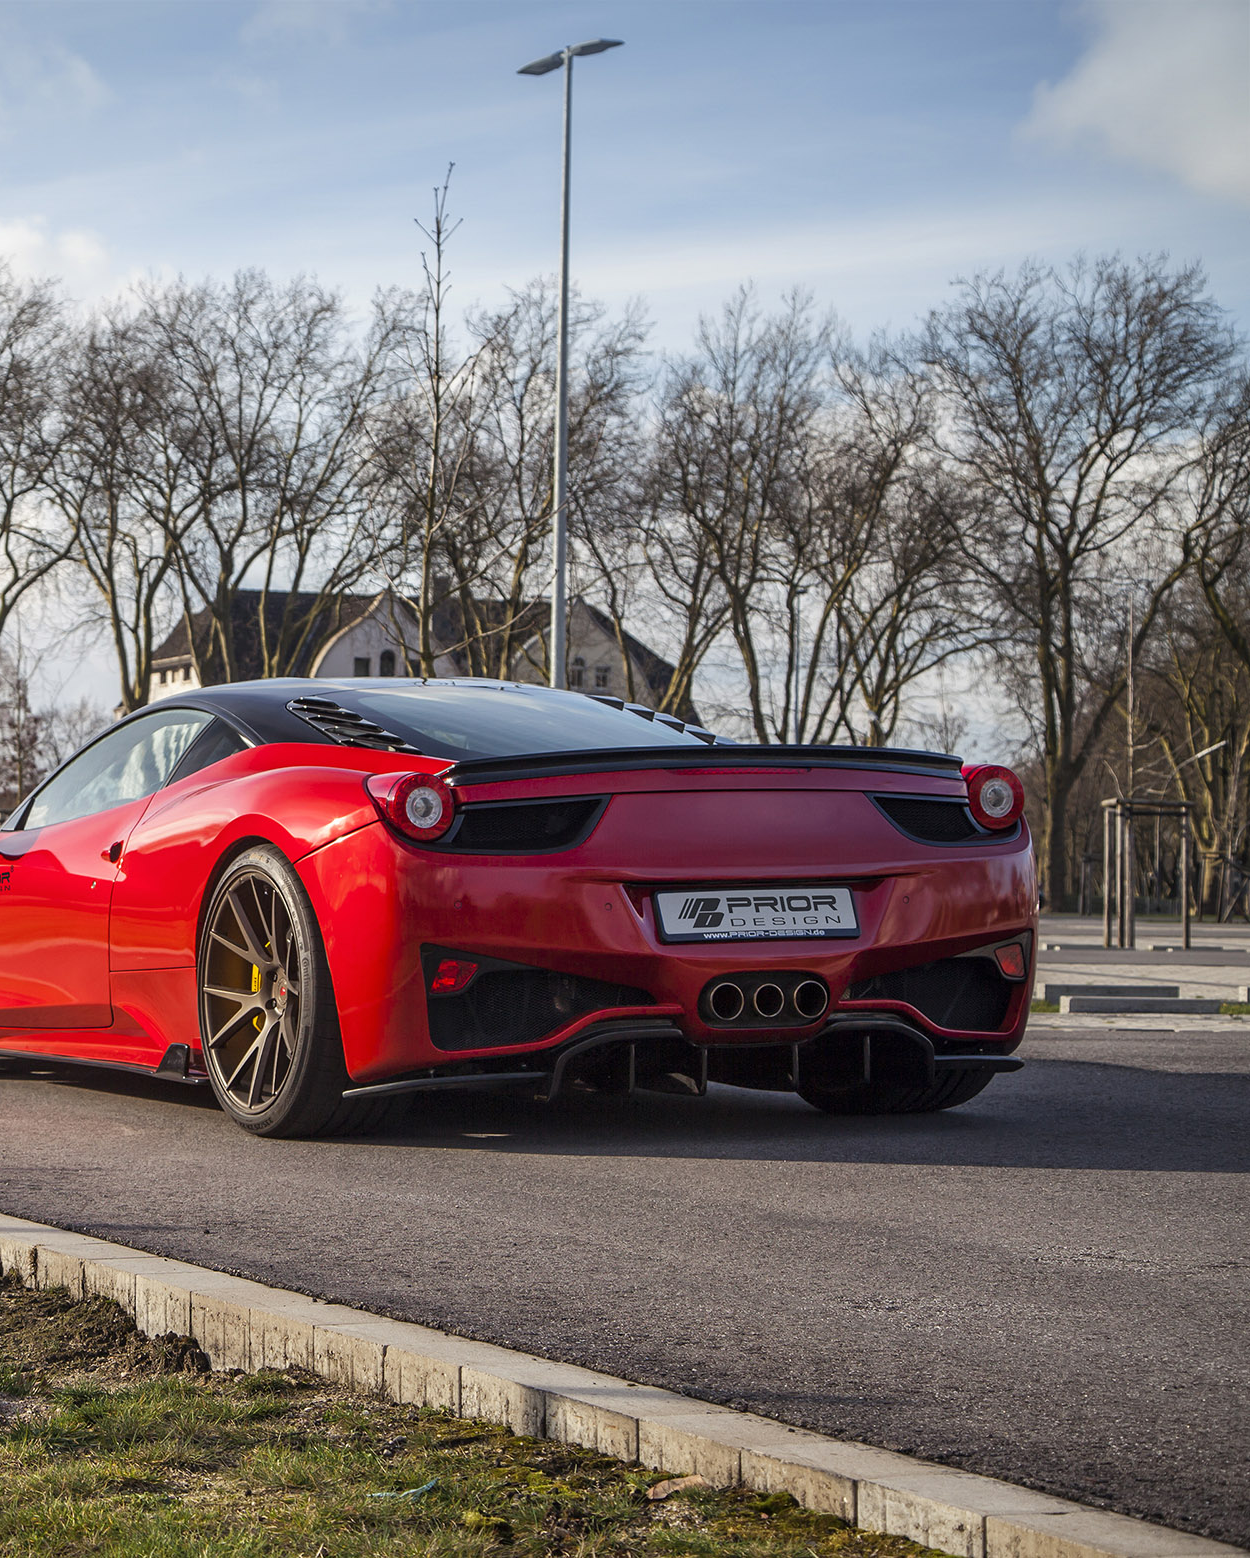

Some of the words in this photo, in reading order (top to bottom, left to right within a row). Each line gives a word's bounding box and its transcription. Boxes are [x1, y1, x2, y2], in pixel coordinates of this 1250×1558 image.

[726, 895, 837, 913] PRIOR
[730, 915, 842, 927] DESIGN
[703, 929, 825, 938] www.PRIOR-DESIGN.de
